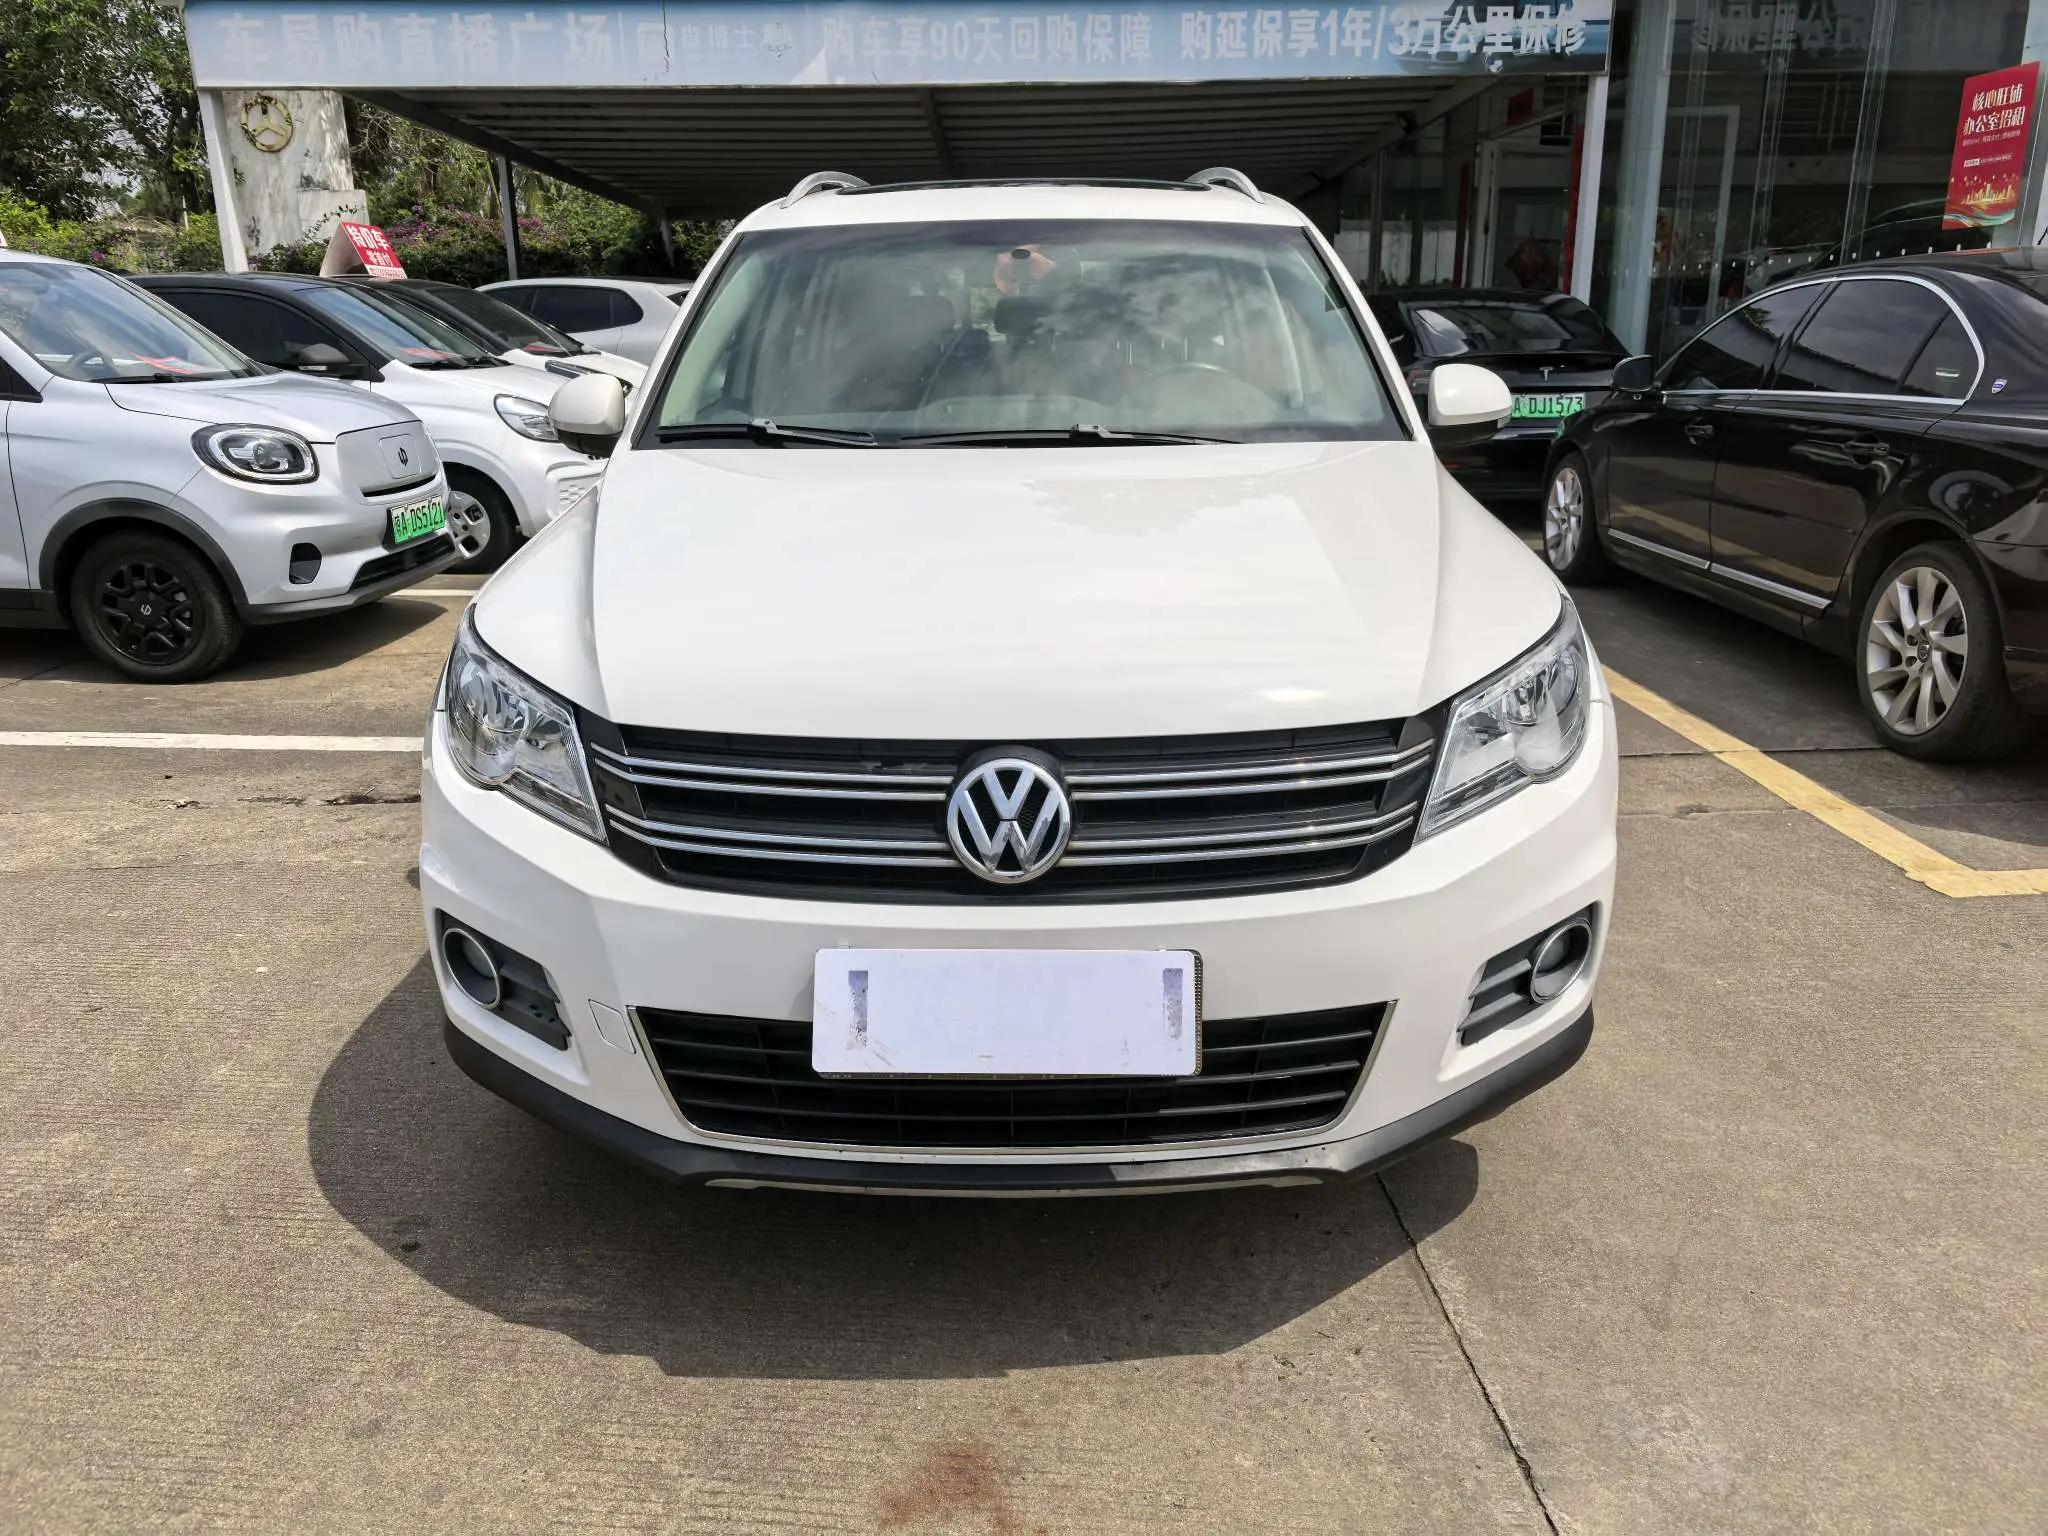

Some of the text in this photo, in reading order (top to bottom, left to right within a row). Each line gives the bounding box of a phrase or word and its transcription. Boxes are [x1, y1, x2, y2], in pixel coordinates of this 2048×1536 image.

[218, 12, 612, 73] 车易购直播广场
[822, 4, 1586, 67] 购车享90天回购保障 购延保享1年/3万公里保修
[1971, 83, 2024, 112] 核心旺铺
[1963, 106, 2025, 136] 办公室招租
